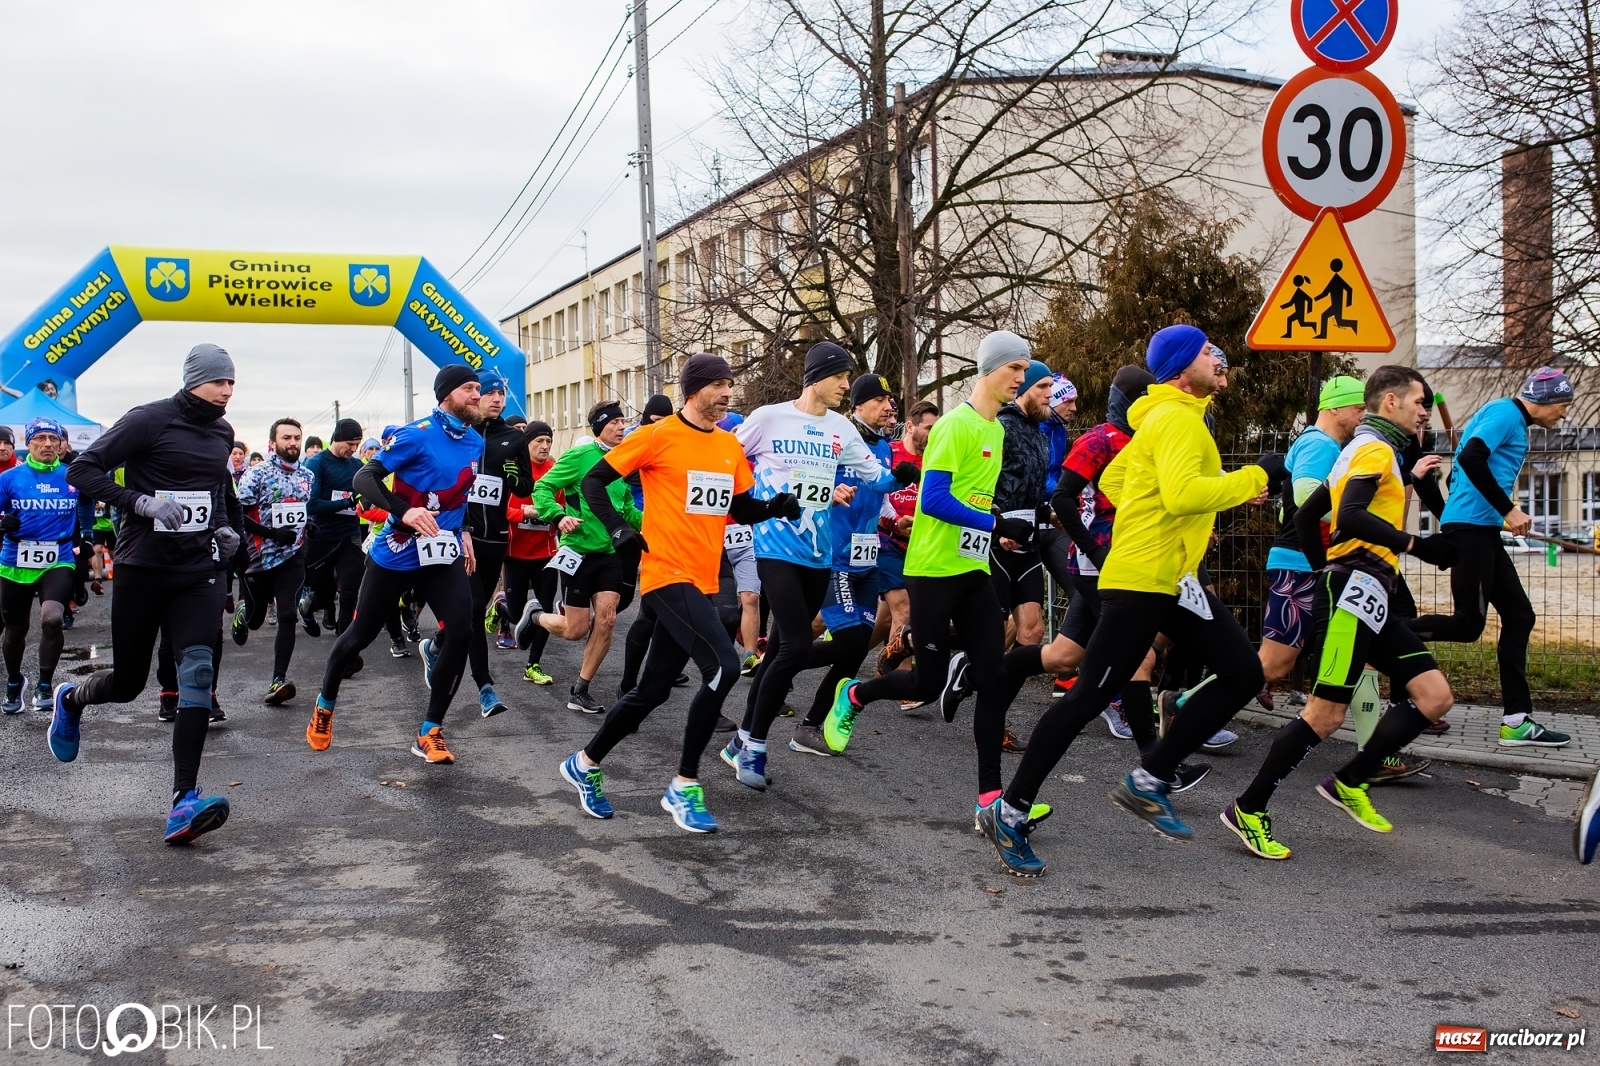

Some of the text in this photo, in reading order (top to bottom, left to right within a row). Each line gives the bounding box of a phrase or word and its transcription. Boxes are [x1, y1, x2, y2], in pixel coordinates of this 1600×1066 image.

[1287, 104, 1383, 182] 30
[229, 260, 311, 273] Gmina
[208, 275, 333, 291] Pietrowice
[24, 270, 112, 349] Gmina ludzi
[225, 293, 317, 308] Wielkie
[44, 290, 127, 364] aktywnych
[421, 282, 501, 357] Gmina ludzi
[408, 299, 484, 369] aktywnych
[690, 487, 731, 508] 205
[793, 483, 831, 503] 128
[275, 512, 305, 524] 162
[725, 530, 752, 544] 123
[961, 532, 989, 554] 247
[21, 550, 56, 563] 150
[422, 543, 458, 558] 173
[853, 546, 877, 560] 216
[1344, 585, 1386, 623] 259
